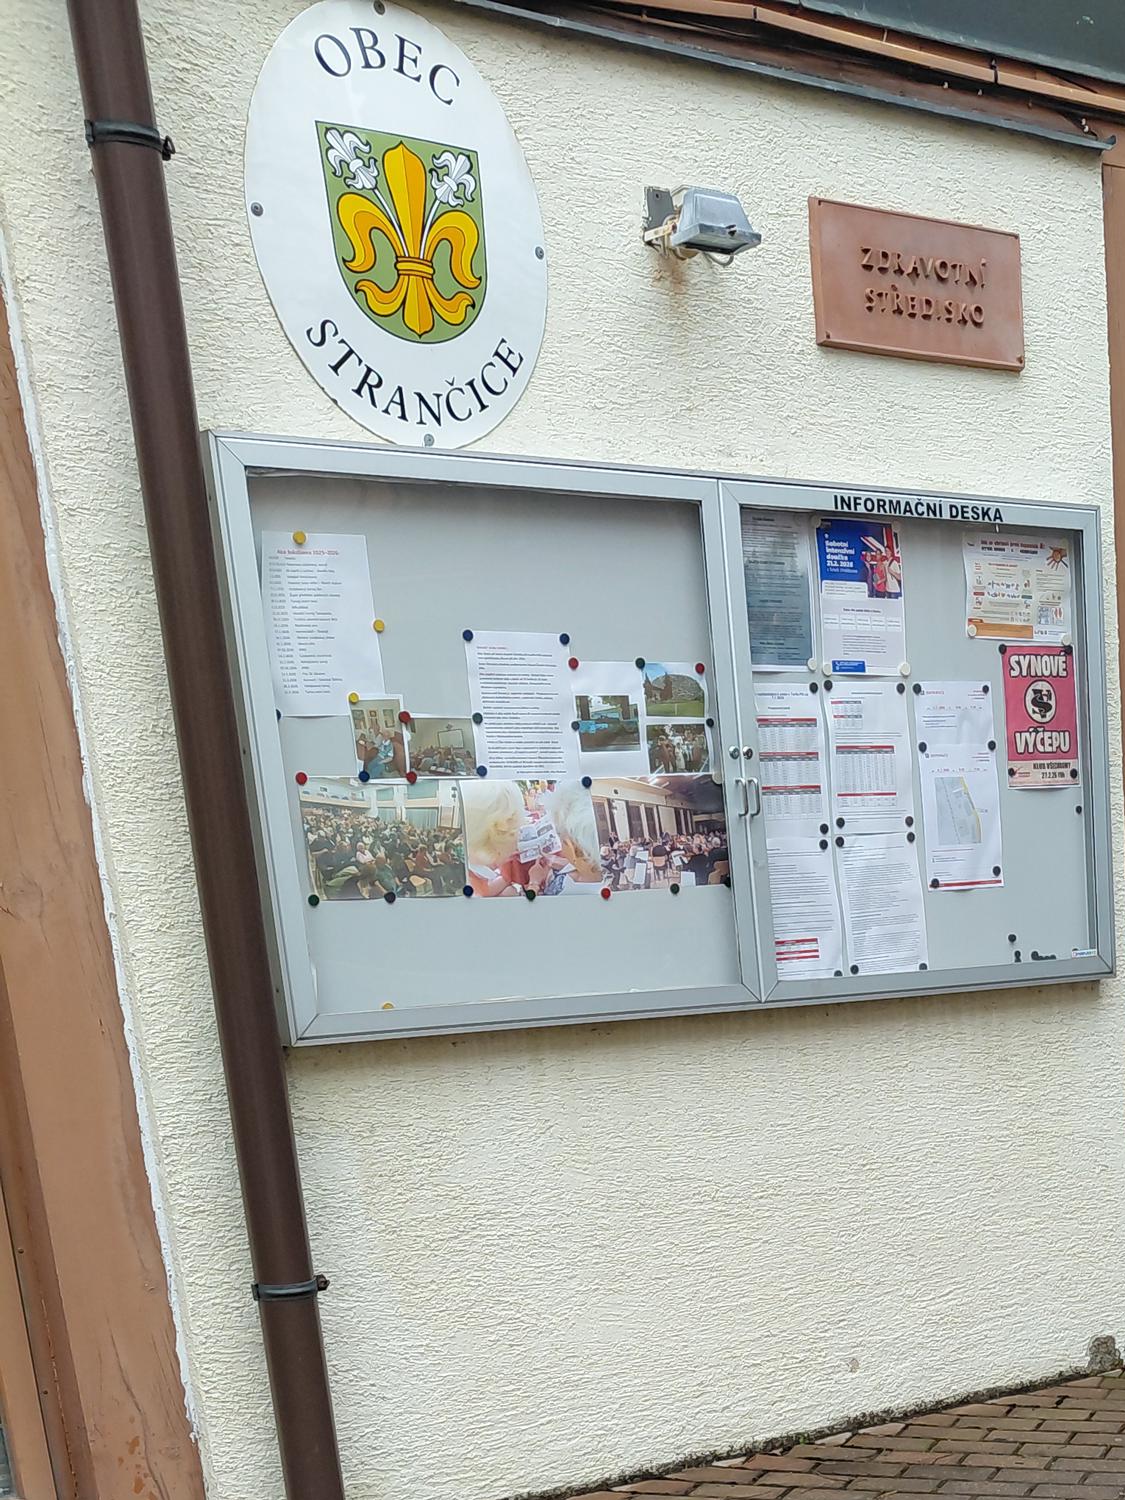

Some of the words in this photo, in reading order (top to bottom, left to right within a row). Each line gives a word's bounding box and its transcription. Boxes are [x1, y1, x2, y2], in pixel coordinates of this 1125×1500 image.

[314, 27, 460, 105] OBEC
[860, 247, 987, 289] ZDRAVOTNÍ
[865, 284, 985, 327] STŘEDISKO
[306, 318, 524, 427] STRANČICE
[832, 494, 943, 518] INFORMAČNÍ
[948, 504, 1004, 523] DESKA
[1009, 651, 1067, 677] SYNOVÉ
[1014, 727, 1071, 754] VÝČEPU
